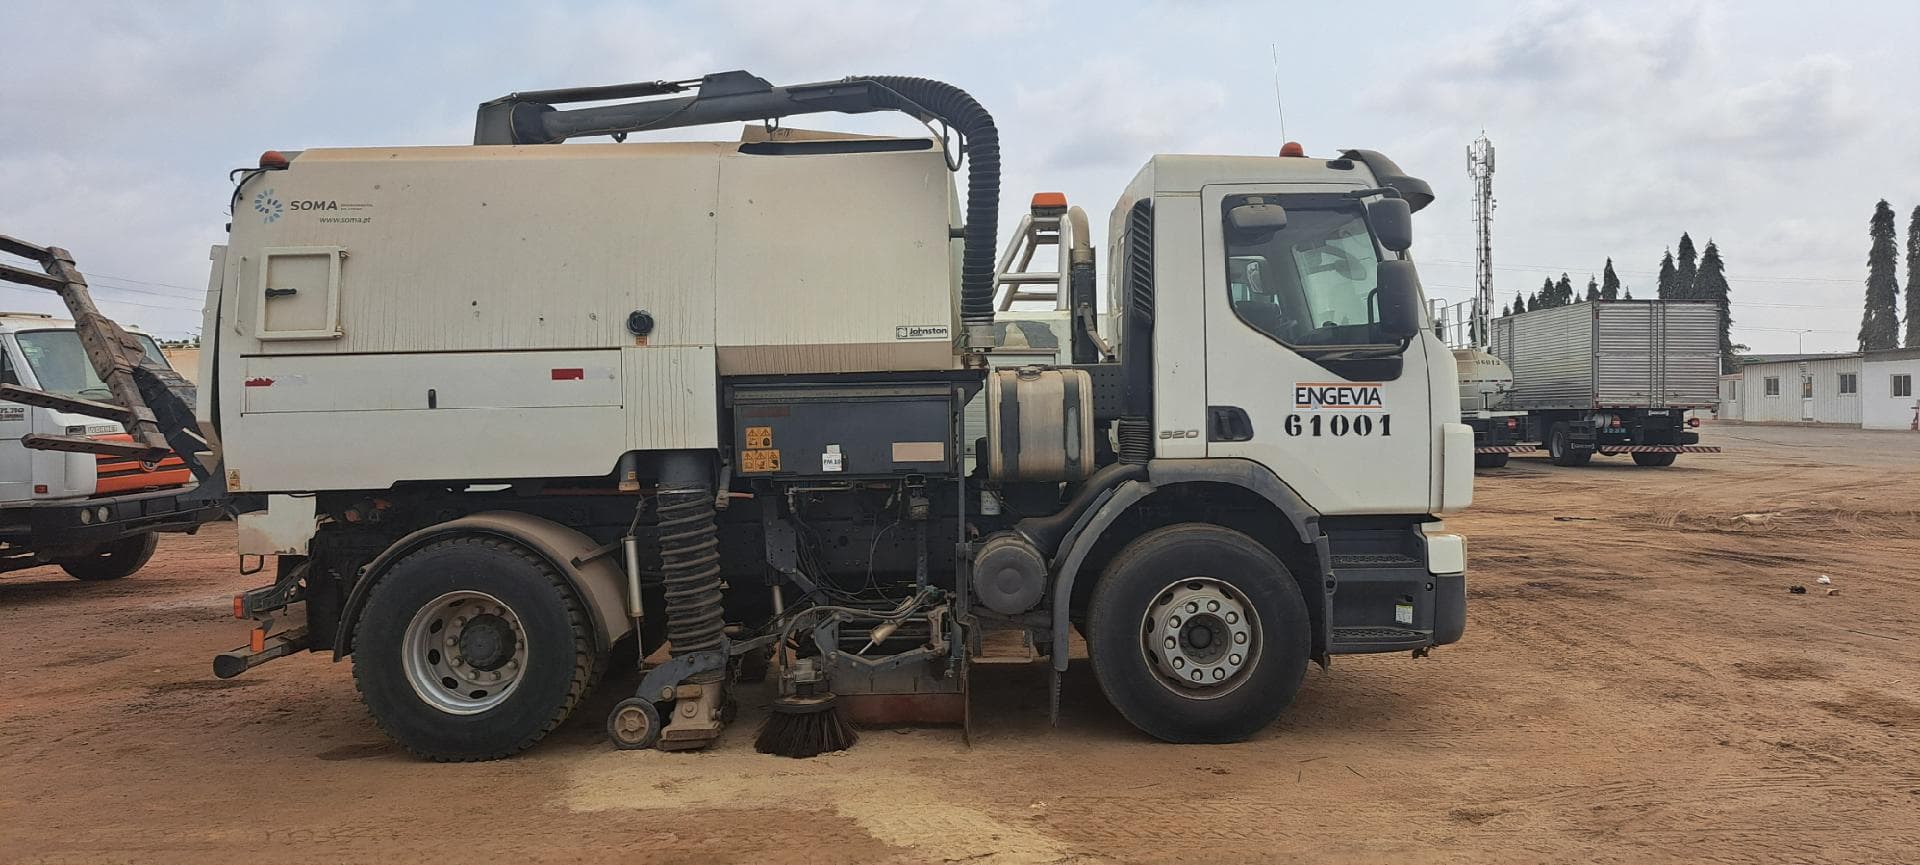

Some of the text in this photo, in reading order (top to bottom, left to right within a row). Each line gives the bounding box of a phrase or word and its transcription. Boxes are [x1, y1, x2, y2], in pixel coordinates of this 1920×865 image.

[290, 200, 338, 210] SOMA
[910, 327, 947, 335] Johnston
[1295, 387, 1382, 405] ENGEVIA
[1284, 414, 1392, 437] 61001
[1158, 430, 1199, 440] 320
